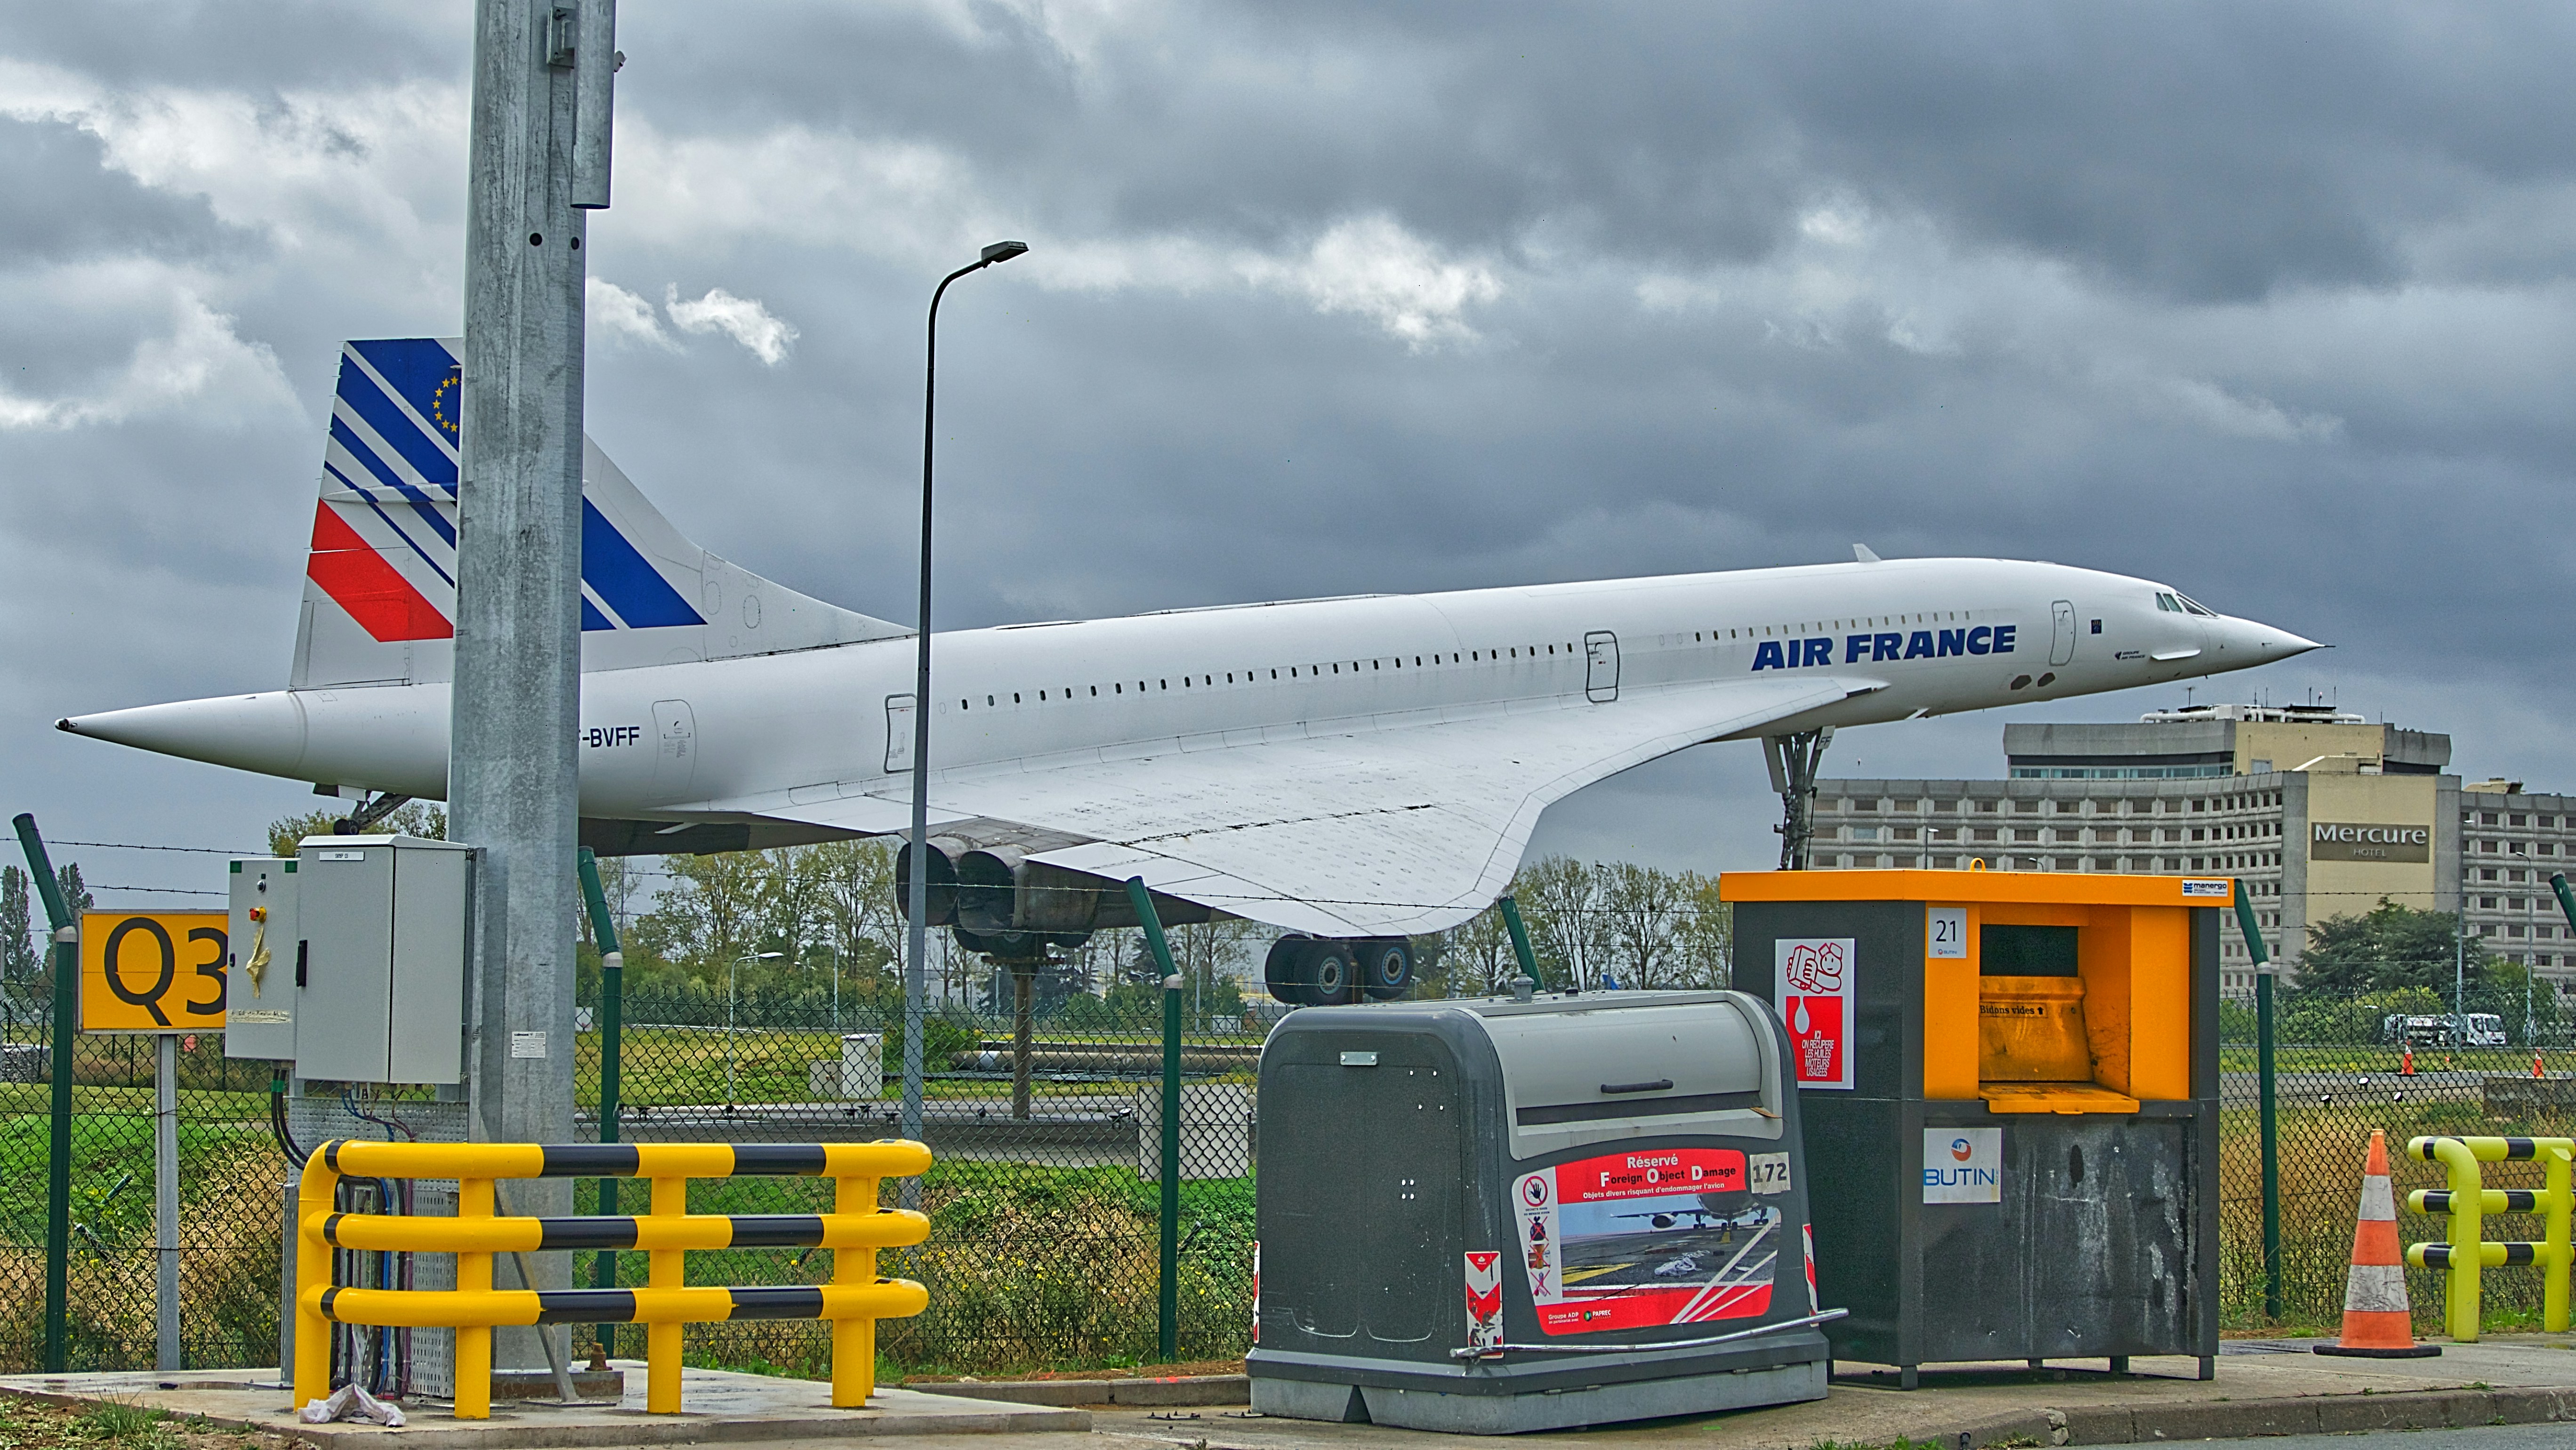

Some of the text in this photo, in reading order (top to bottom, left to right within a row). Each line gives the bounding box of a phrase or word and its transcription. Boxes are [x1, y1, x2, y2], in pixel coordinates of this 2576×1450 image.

[1751, 625, 2016, 671] AIR FRANCE
[579, 726, 640, 748] -BVFF
[1819, 736, 1832, 746] FF
[2315, 824, 2427, 844] Mercure
[2354, 849, 2386, 857] HOTEL
[1936, 920, 1956, 942] 21
[104, 917, 228, 1026] Q3
[1980, 1005, 2035, 1014] Bidons vides
[1802, 1039, 1835, 1049] ON RECUPERE
[1805, 1049, 1831, 1059] LES HUILES
[1805, 1058, 1830, 1068] MOTEURS
[1627, 1153, 1678, 1168] Réservé
[1601, 1165, 1736, 1187] Foreign Object Damage
[1753, 1163, 1787, 1183] 172
[1924, 1168, 1995, 1186] BUTIN
[1627, 1188, 1654, 1196] risquant
[1655, 1184, 1702, 1193] d'endommager
